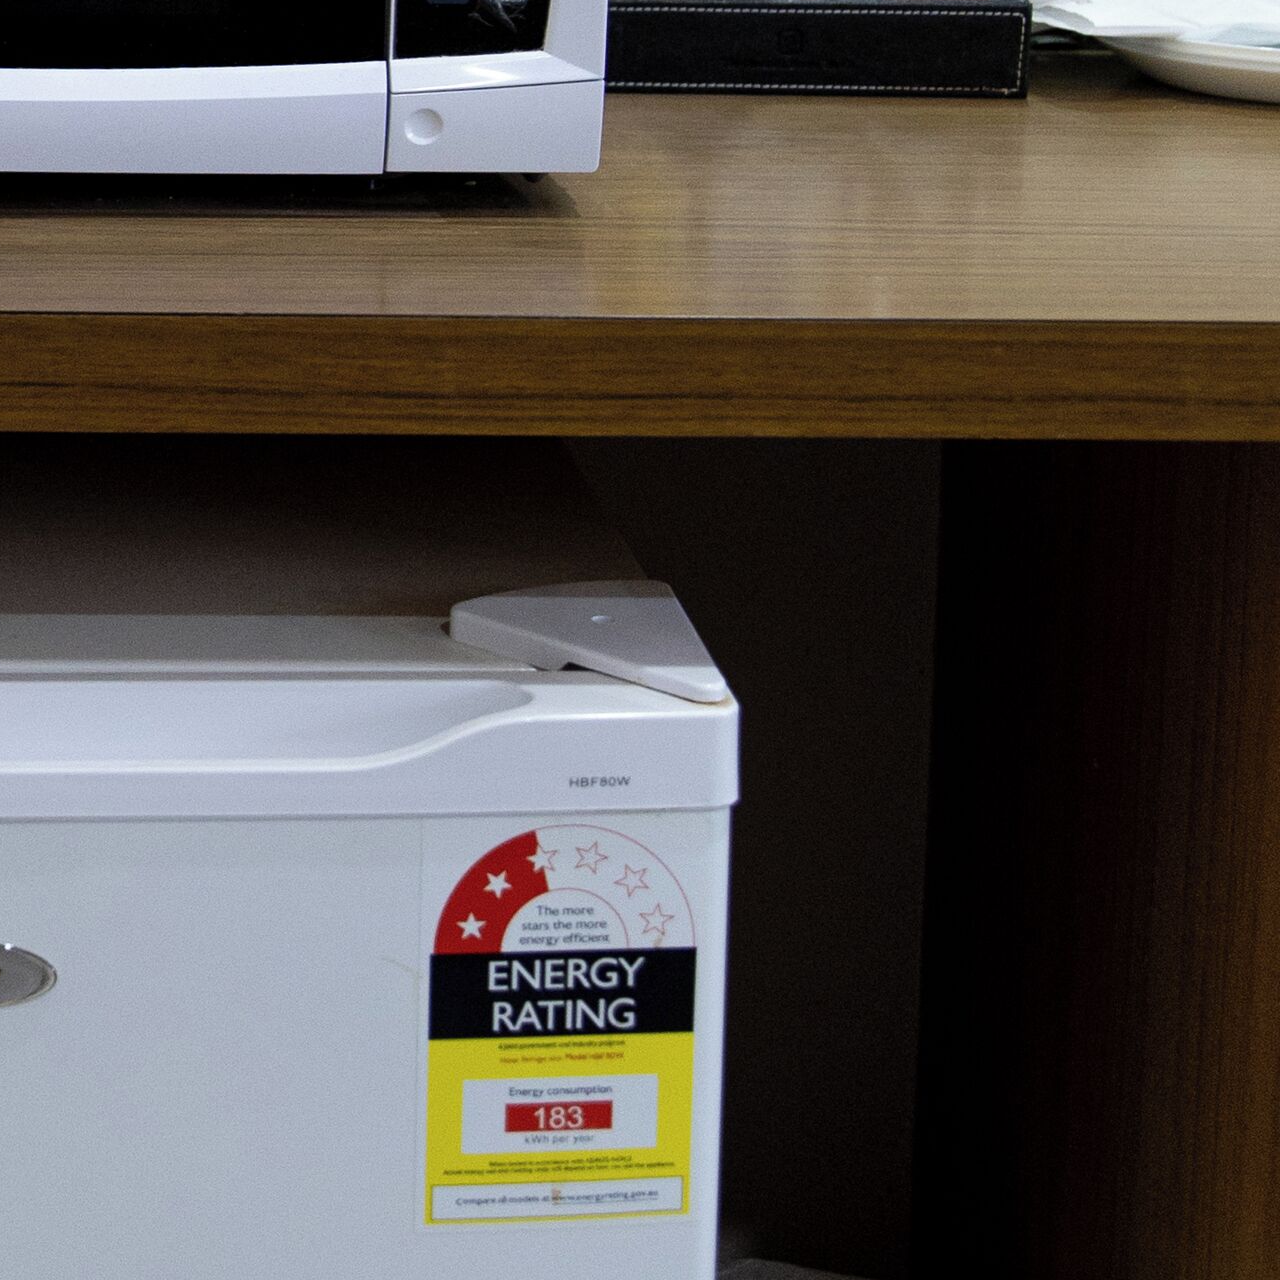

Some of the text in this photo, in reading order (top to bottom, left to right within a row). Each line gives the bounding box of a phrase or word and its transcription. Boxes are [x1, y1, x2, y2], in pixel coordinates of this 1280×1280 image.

[569, 776, 631, 788] HBF80W
[536, 904, 594, 916] The more
[521, 920, 608, 931] stars the more
[519, 932, 610, 946] energy efficient
[488, 956, 645, 991] ENERGY
[492, 997, 636, 1032] RATING
[508, 1085, 613, 1097] Energy consumption
[534, 1105, 584, 1129] 183
[524, 1134, 594, 1144] kWh per year
